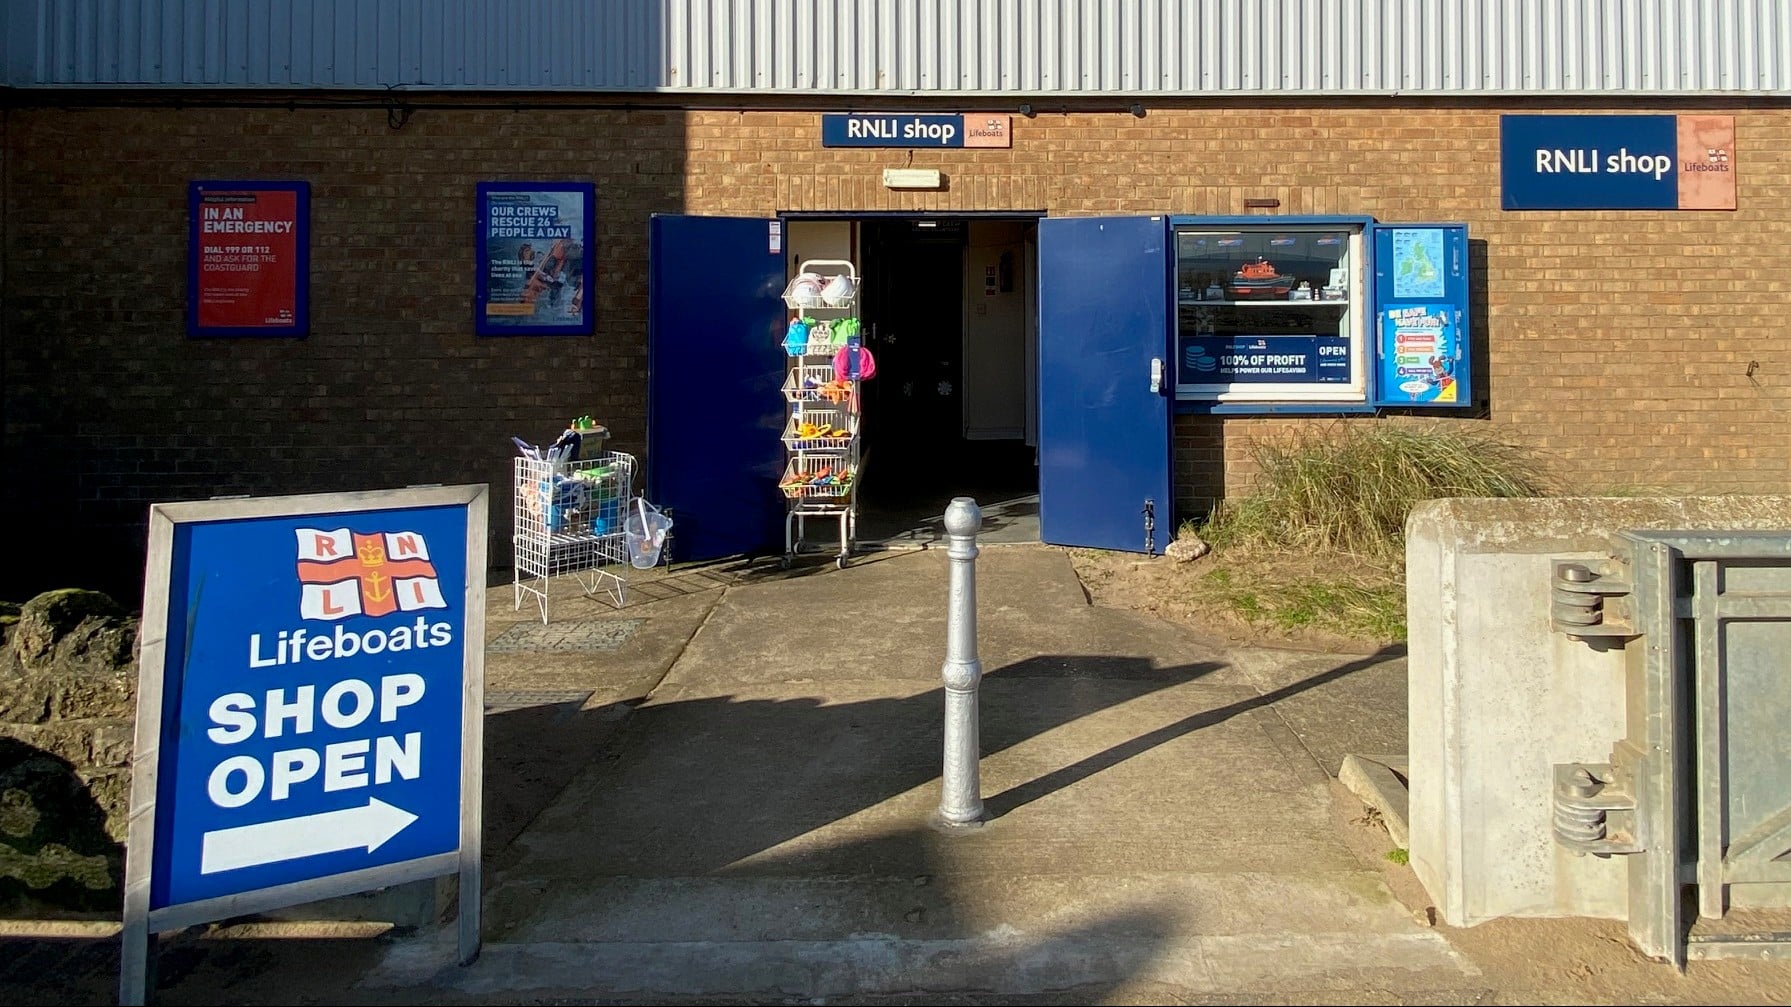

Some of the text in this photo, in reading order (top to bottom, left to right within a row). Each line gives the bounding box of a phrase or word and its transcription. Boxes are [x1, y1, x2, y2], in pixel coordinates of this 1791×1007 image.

[848, 118, 956, 144] RNLI shop
[969, 129, 1003, 138] Lifeboats
[1536, 148, 1671, 181] RNLI shop
[1684, 162, 1729, 172] Lifeboats
[204, 208, 243, 219] IN AN
[491, 206, 557, 216] OUR CREWS
[204, 221, 293, 233] EMERGENCY
[491, 217, 551, 227] RESCUE 26
[491, 228, 569, 237] PEOPLE A DAY
[204, 246, 270, 254] DIAL 999 OR 112
[204, 255, 277, 263] AND ASK FOR THE
[204, 263, 259, 272] COASTGUARD
[1318, 346, 1347, 356] OPEN
[1220, 354, 1249, 366] 100%
[1250, 354, 1265, 366] OF
[1266, 354, 1306, 366] PROFIT
[315, 534, 418, 557] R N
[321, 582, 424, 616] L I
[249, 617, 453, 669] Lifeboats
[207, 673, 426, 745] SHOP
[207, 732, 422, 808] OPEN
